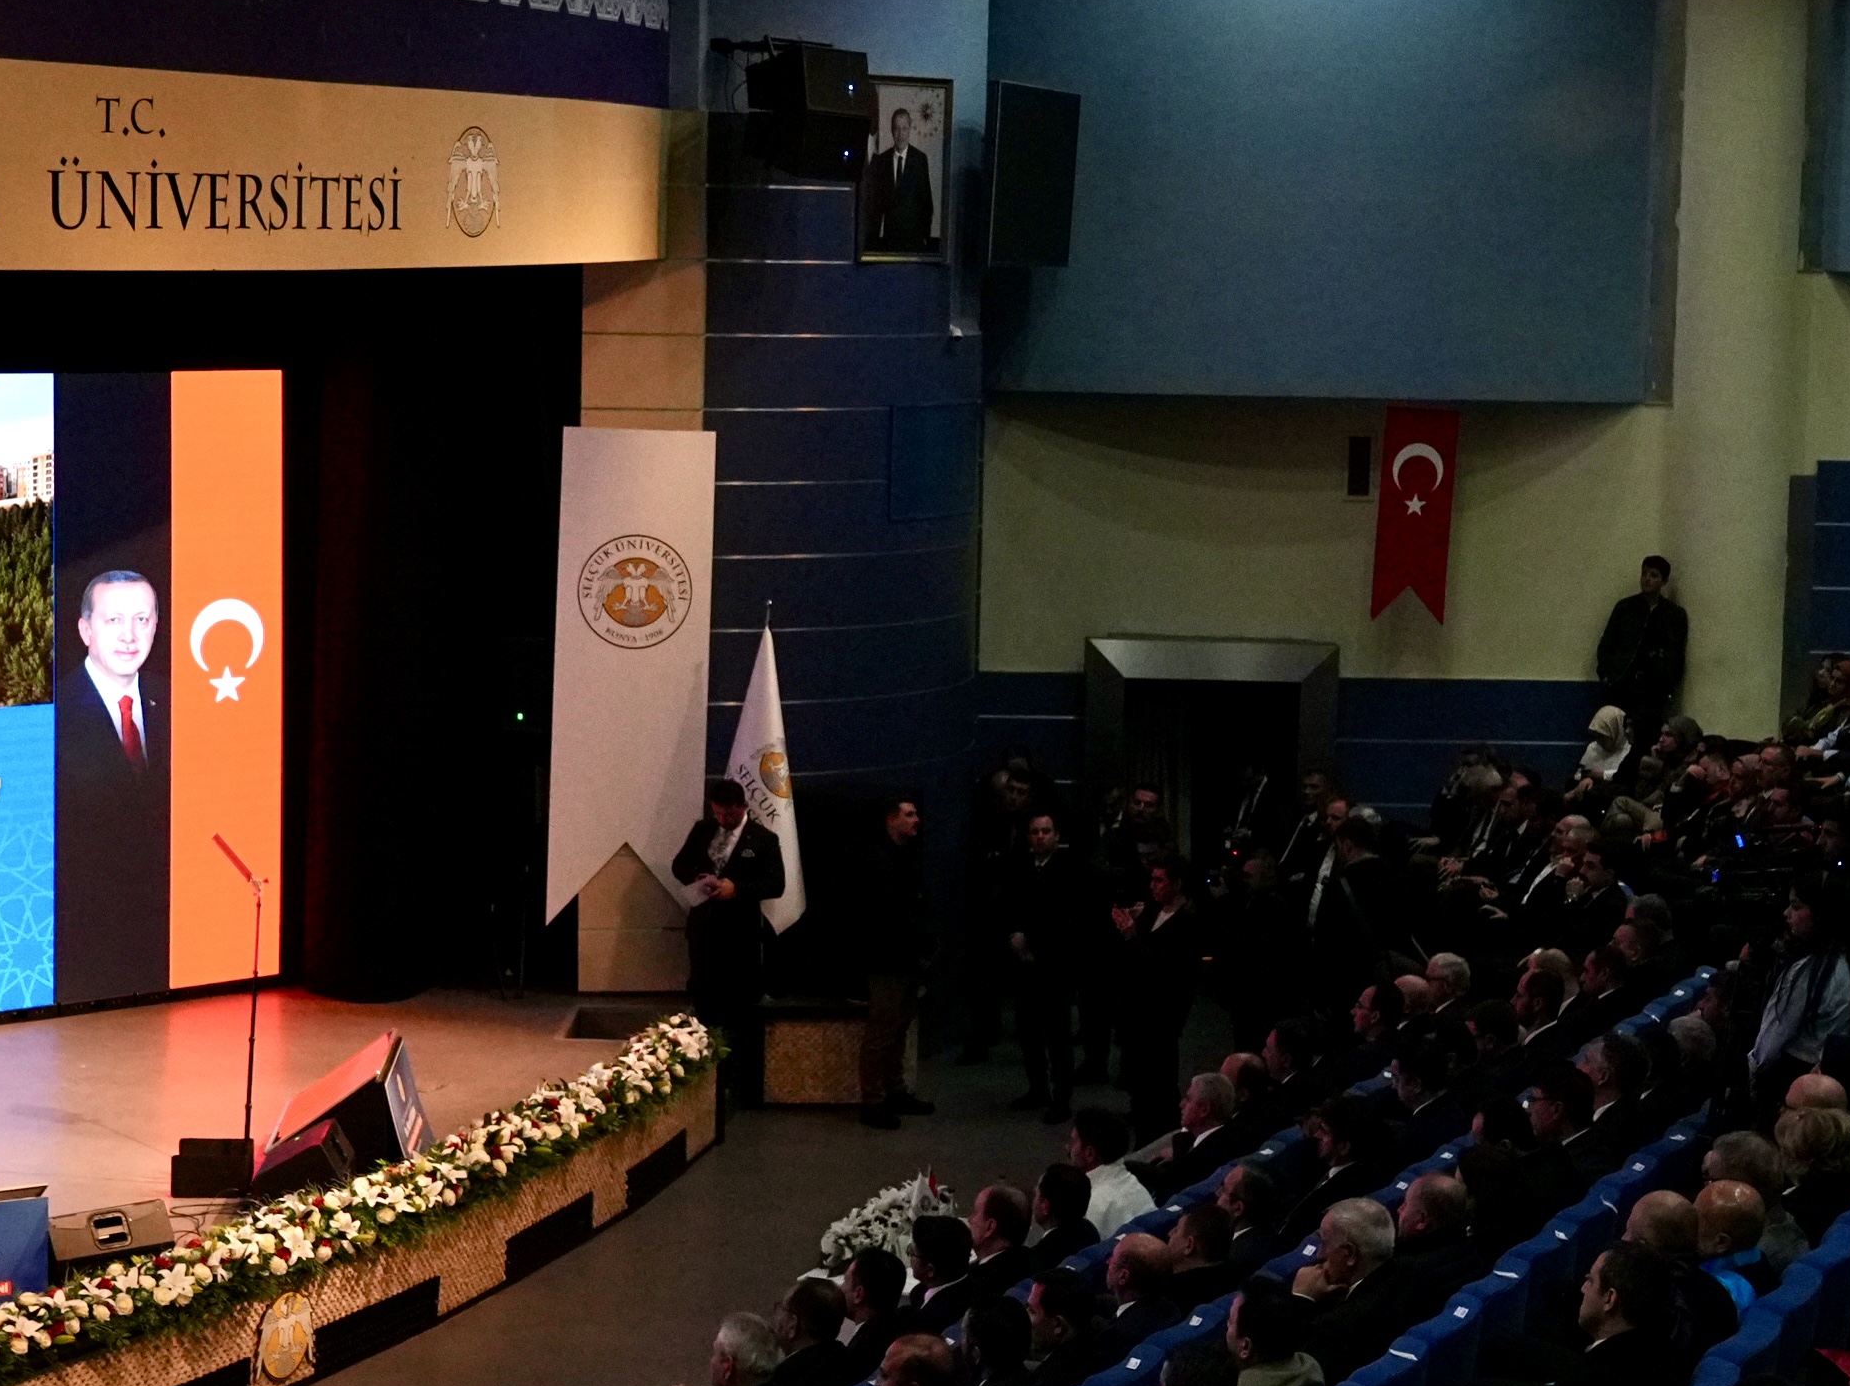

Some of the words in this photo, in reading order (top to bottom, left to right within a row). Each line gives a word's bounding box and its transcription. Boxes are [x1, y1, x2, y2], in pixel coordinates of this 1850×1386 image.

[95, 94, 166, 138] T.C.
[46, 155, 403, 237] ÜNİVERSİTESİ
[582, 547, 614, 599] SELÇUK
[614, 539, 688, 601] ÜNİVERSİTESİ
